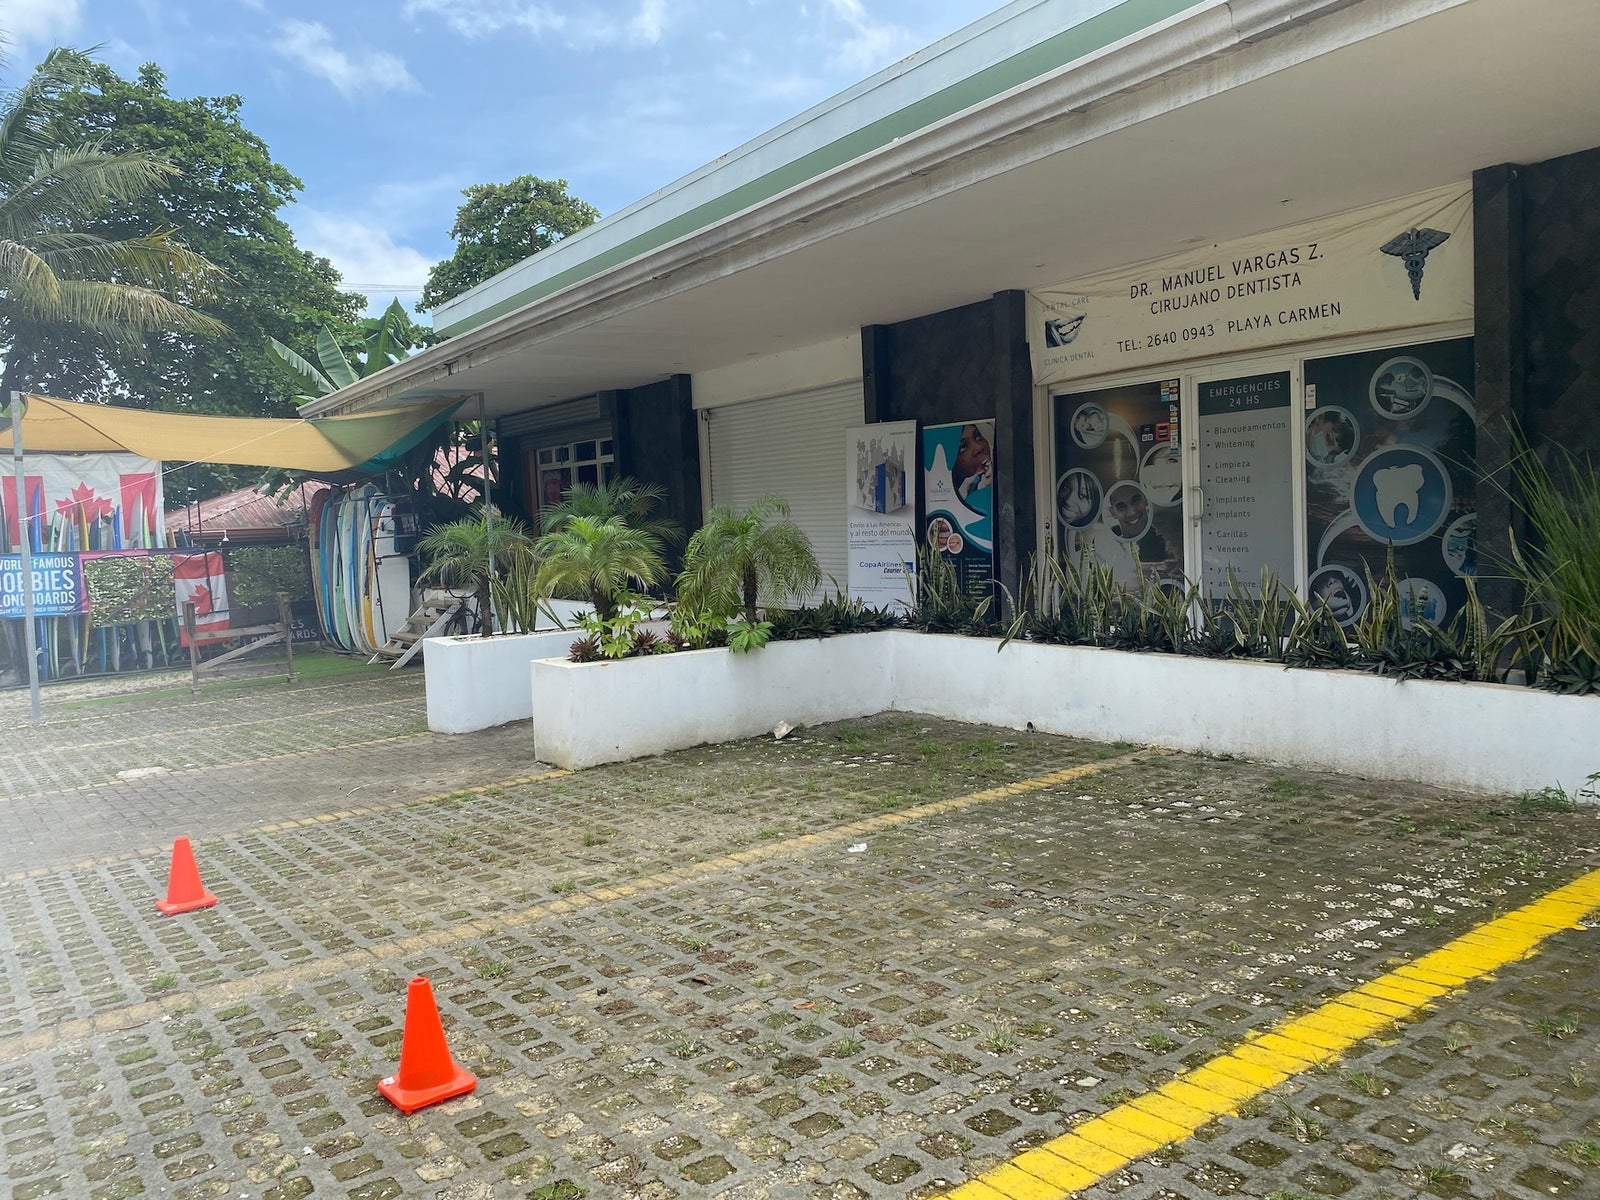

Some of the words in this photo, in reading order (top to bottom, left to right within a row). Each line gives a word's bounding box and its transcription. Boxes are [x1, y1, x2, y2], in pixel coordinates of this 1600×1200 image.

[1130, 282, 1153, 299] DR.
[1161, 265, 1225, 292] MANUEL
[1232, 247, 1300, 276] VARGAS
[1308, 243, 1324, 260] Z.
[1150, 288, 1221, 315] CIRUJANO
[1227, 272, 1302, 299] DENTISTA
[1117, 338, 1142, 353] TEL:
[1147, 331, 1177, 348] 2640
[1182, 324, 1215, 341] 0943
[1228, 314, 1272, 333] PLAYA
[1278, 301, 1341, 325] CARMEN
[1070, 351, 1096, 362] DENTAL
[1209, 380, 1281, 398] EMERGENCIES
[1229, 398, 1242, 407] 24
[1246, 395, 1260, 405] HS
[1214, 421, 1286, 435] Blanqueamientos
[1214, 440, 1255, 449] Whitening
[1215, 461, 1251, 470] Limpieza
[1215, 475, 1252, 484] Cleaning
[1216, 496, 1256, 504] Implantes
[1216, 510, 1251, 519] Implants
[879, 529, 889, 537] del
[1216, 530, 1249, 538] Carillas
[1217, 545, 1250, 553] Veneers
[33, 556, 75, 569] FAMOUS
